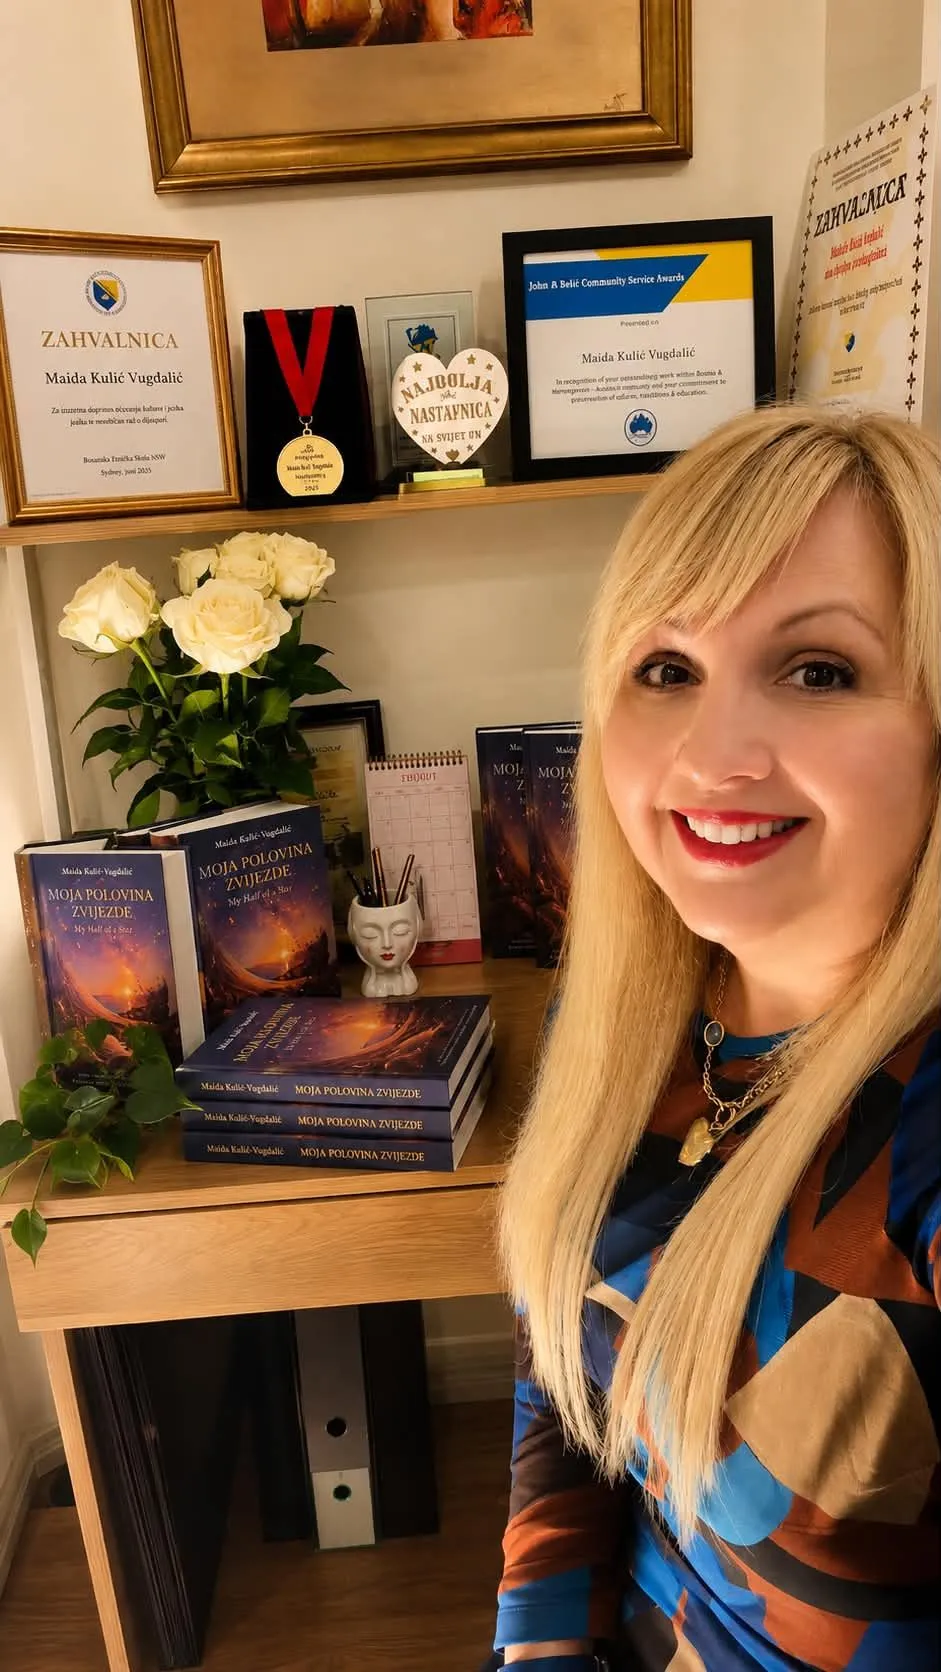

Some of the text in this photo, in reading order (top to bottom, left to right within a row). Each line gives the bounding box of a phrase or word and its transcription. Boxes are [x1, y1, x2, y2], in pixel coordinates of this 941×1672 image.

[528, 281, 548, 291] John
[560, 279, 579, 289] Belić
[581, 276, 626, 288] Community
[628, 274, 655, 285] Service
[656, 273, 685, 283] Awards
[41, 331, 179, 349] ZAHVALNICA
[582, 347, 696, 363] Maida Kulić Vugdalić
[45, 371, 184, 387] Maida Kulić Vugdalić
[199, 842, 313, 880] MOJA POLOVINA
[225, 864, 292, 892] ZVIJEZDE
[48, 888, 154, 902] MOJA POLOVINA
[71, 905, 133, 920] ZVIJEZDE
[201, 1082, 224, 1091] Maida
[295, 1085, 422, 1099] MOJA POLOVINA ZVIJEZDE
[297, 1115, 423, 1131] MOJA POLOVINA ZVIJEZDE
[300, 1147, 425, 1162] MOJA POLOVINA ZVIJEZDE
